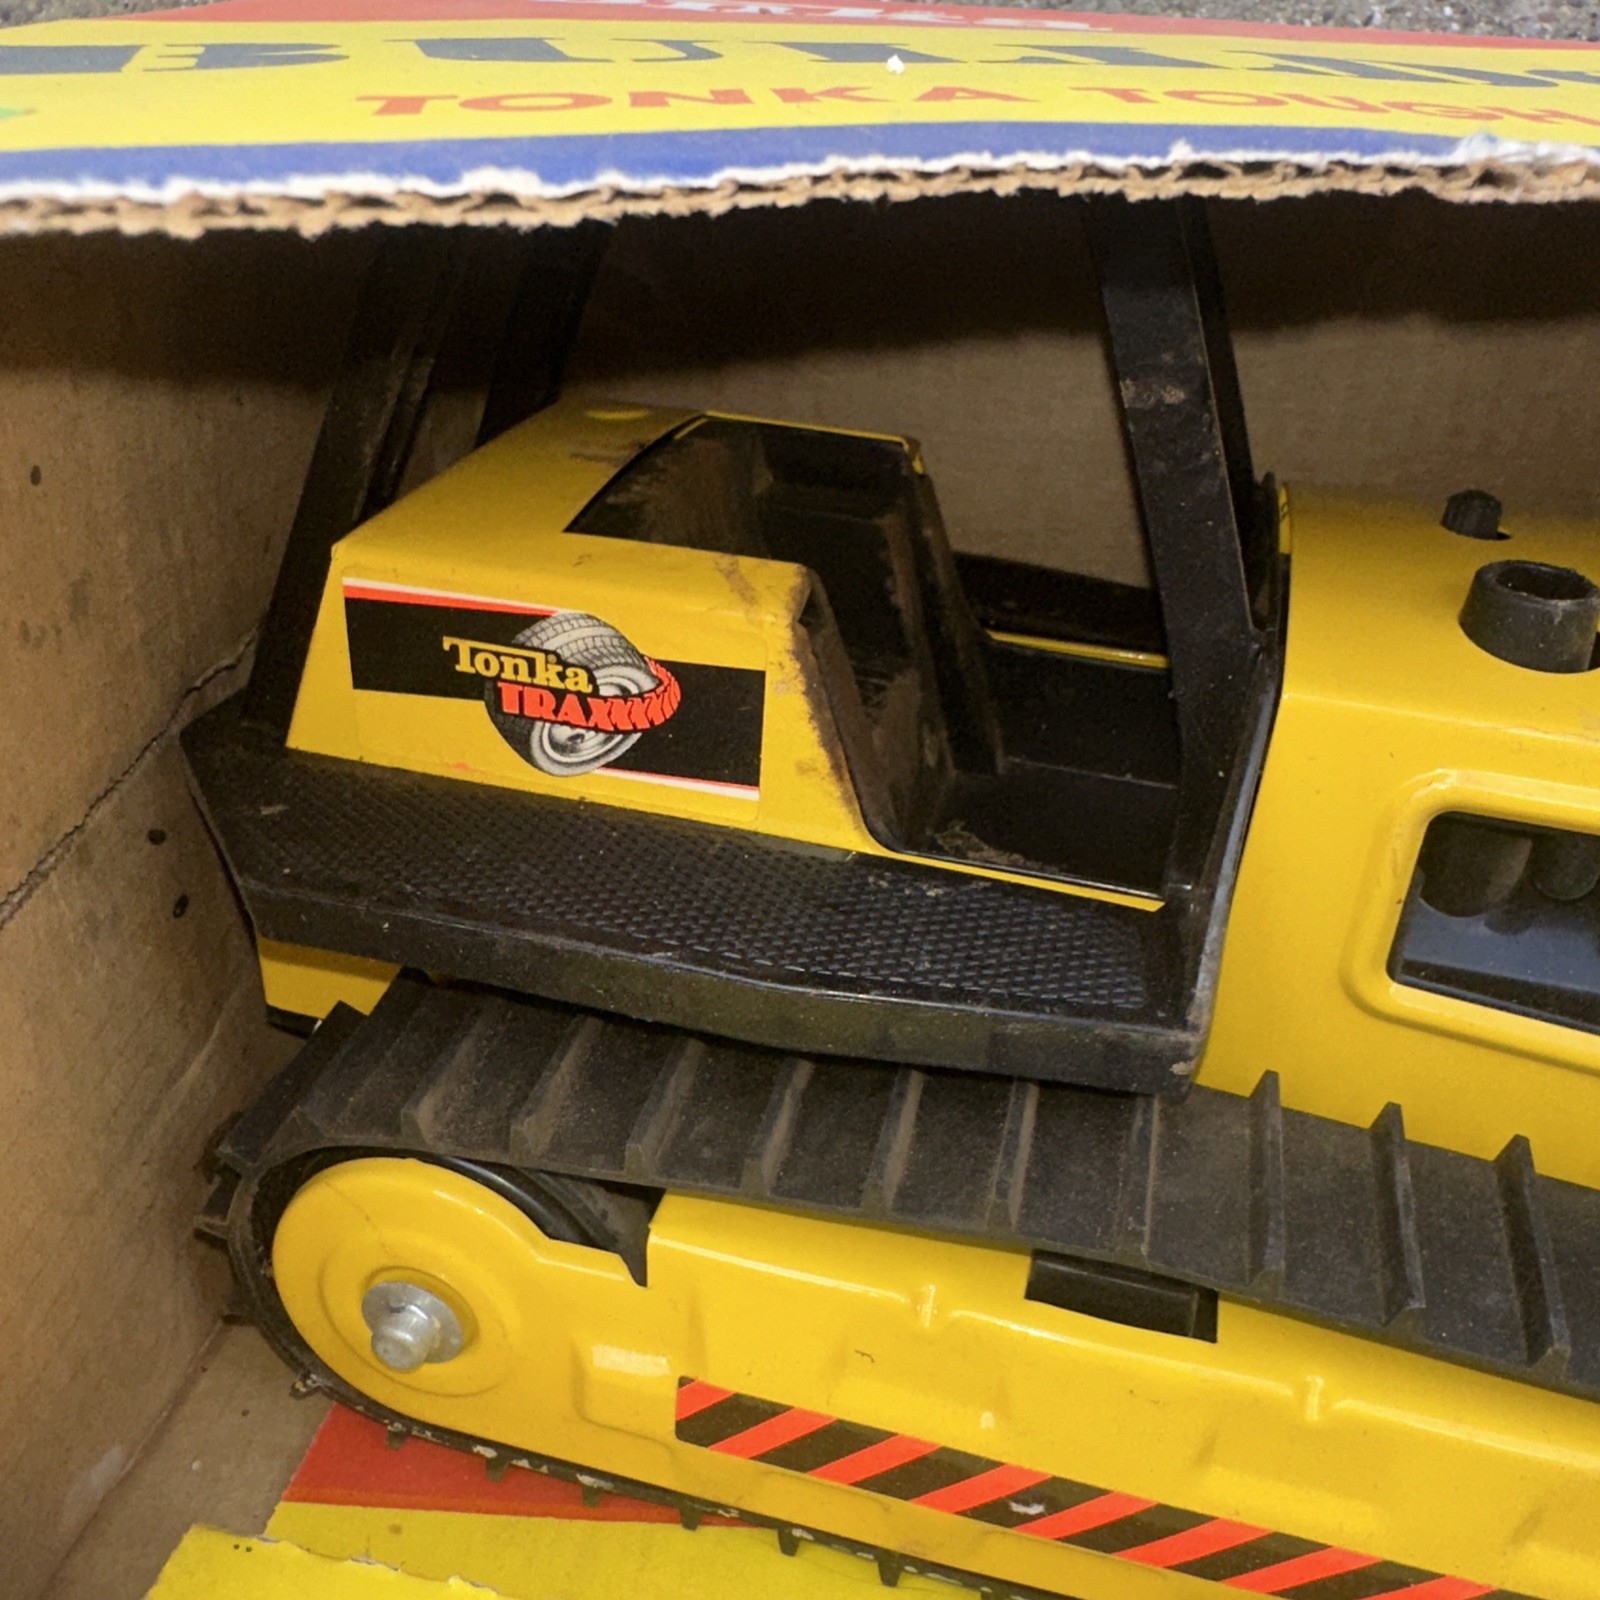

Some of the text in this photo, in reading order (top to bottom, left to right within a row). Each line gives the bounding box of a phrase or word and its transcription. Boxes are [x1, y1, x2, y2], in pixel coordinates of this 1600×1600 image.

[357, 85, 1600, 127] TONKA TOUGH
[443, 636, 593, 694] Tonka
